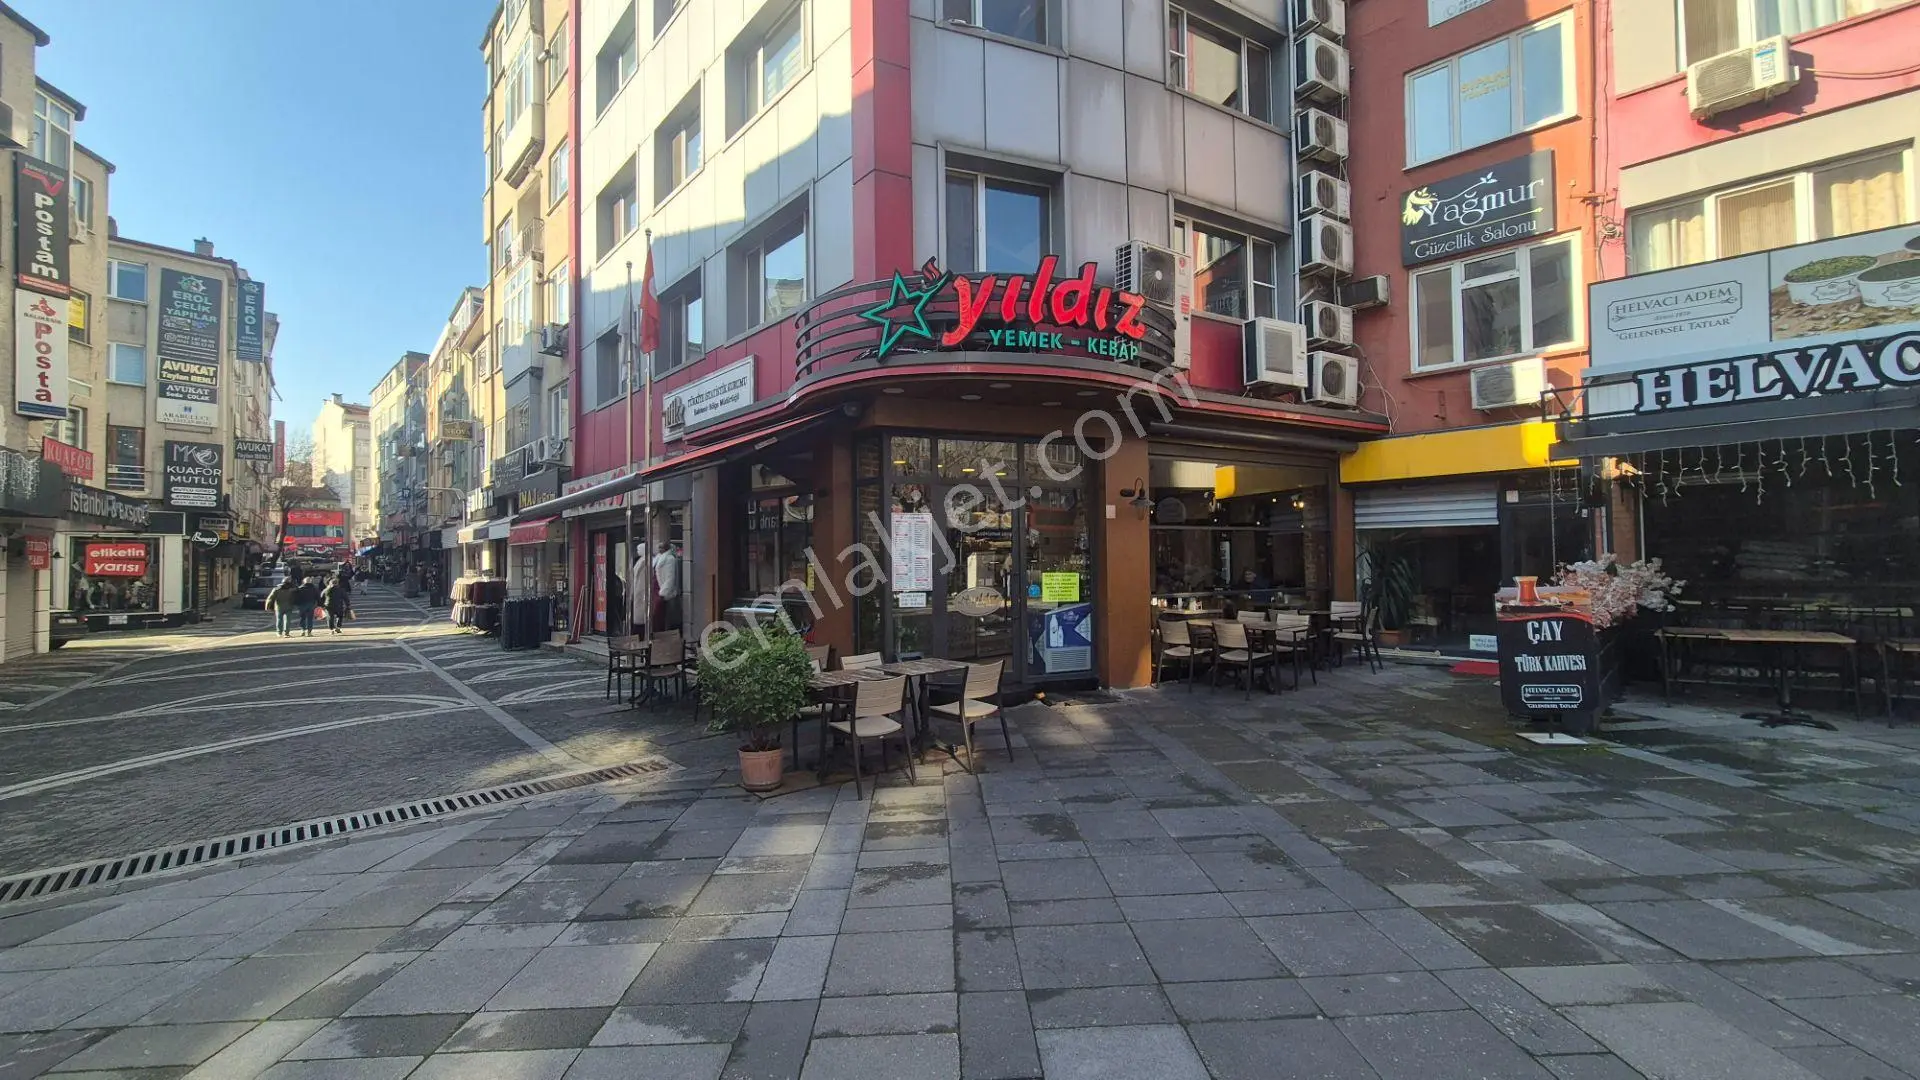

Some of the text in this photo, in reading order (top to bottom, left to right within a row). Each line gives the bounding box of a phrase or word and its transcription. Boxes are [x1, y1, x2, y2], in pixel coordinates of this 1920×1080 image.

[1420, 178, 1544, 226] Yağmur
[1415, 219, 1537, 259] Güzellik Salonu
[172, 290, 213, 305] EROL
[941, 255, 1147, 347] yıldız
[1616, 288, 1732, 314] HELVACI ADEM
[166, 308, 217, 323] YAPILAR
[244, 294, 256, 335] EROL
[989, 328, 1063, 350] YEMEK
[1087, 337, 1140, 361] KEBAP
[35, 322, 52, 402] Posta
[162, 360, 216, 376] AVUKAT
[166, 384, 210, 395] AVUKAT
[236, 441, 272, 452] AVUKAT
[170, 475, 218, 485] MUTLU
[90, 543, 145, 558] etiketin
[1526, 620, 1563, 644] ÇAY
[1514, 654, 1587, 672] TÜRK KAHVESİ
